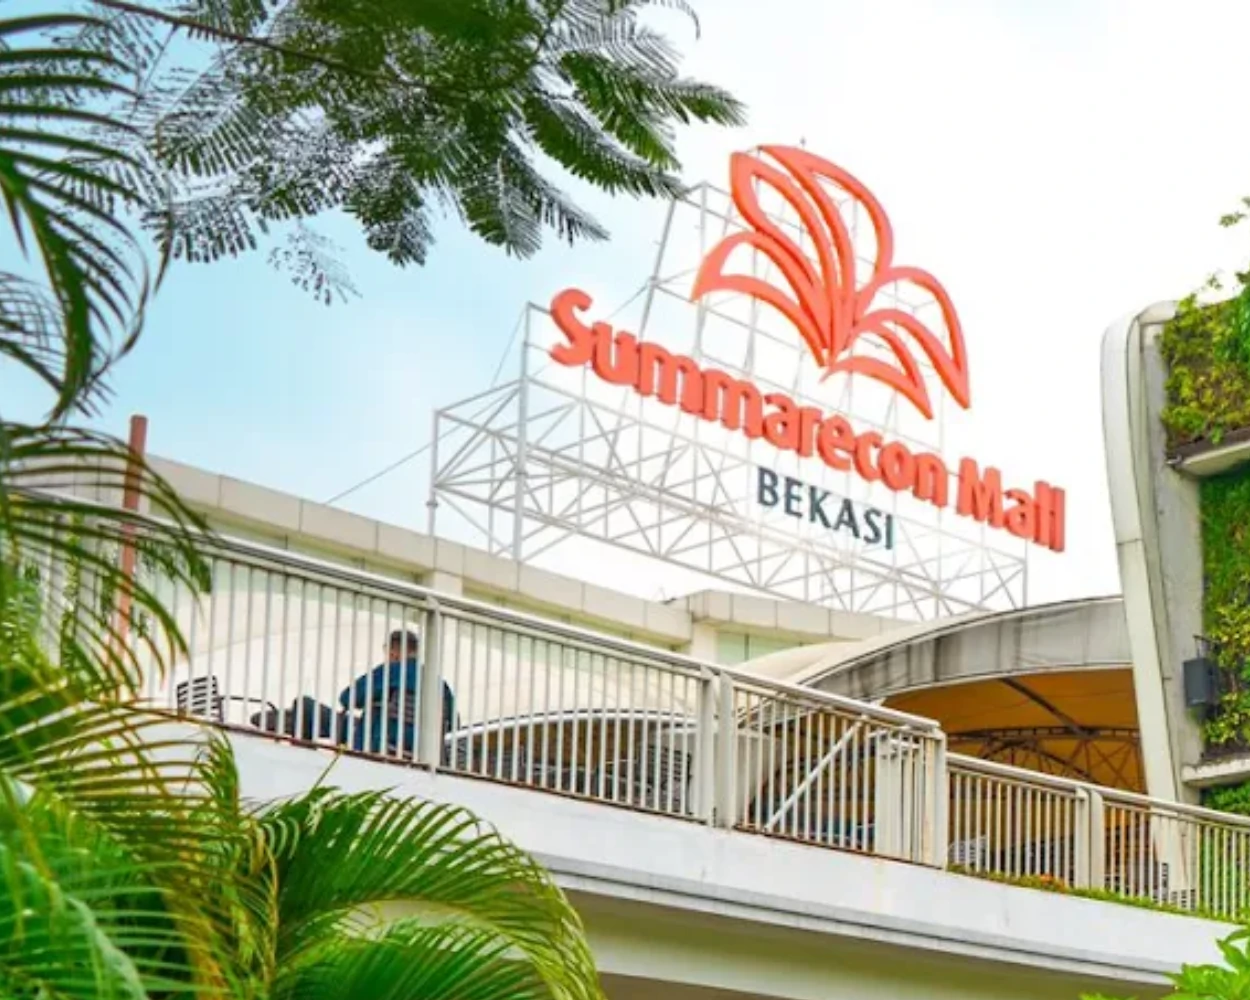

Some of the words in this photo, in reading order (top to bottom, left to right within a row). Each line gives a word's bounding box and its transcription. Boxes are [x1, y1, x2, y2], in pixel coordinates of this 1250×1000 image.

[548, 288, 947, 508] Summarecon
[957, 456, 1066, 553] Mall
[757, 466, 895, 550] BEKASI
